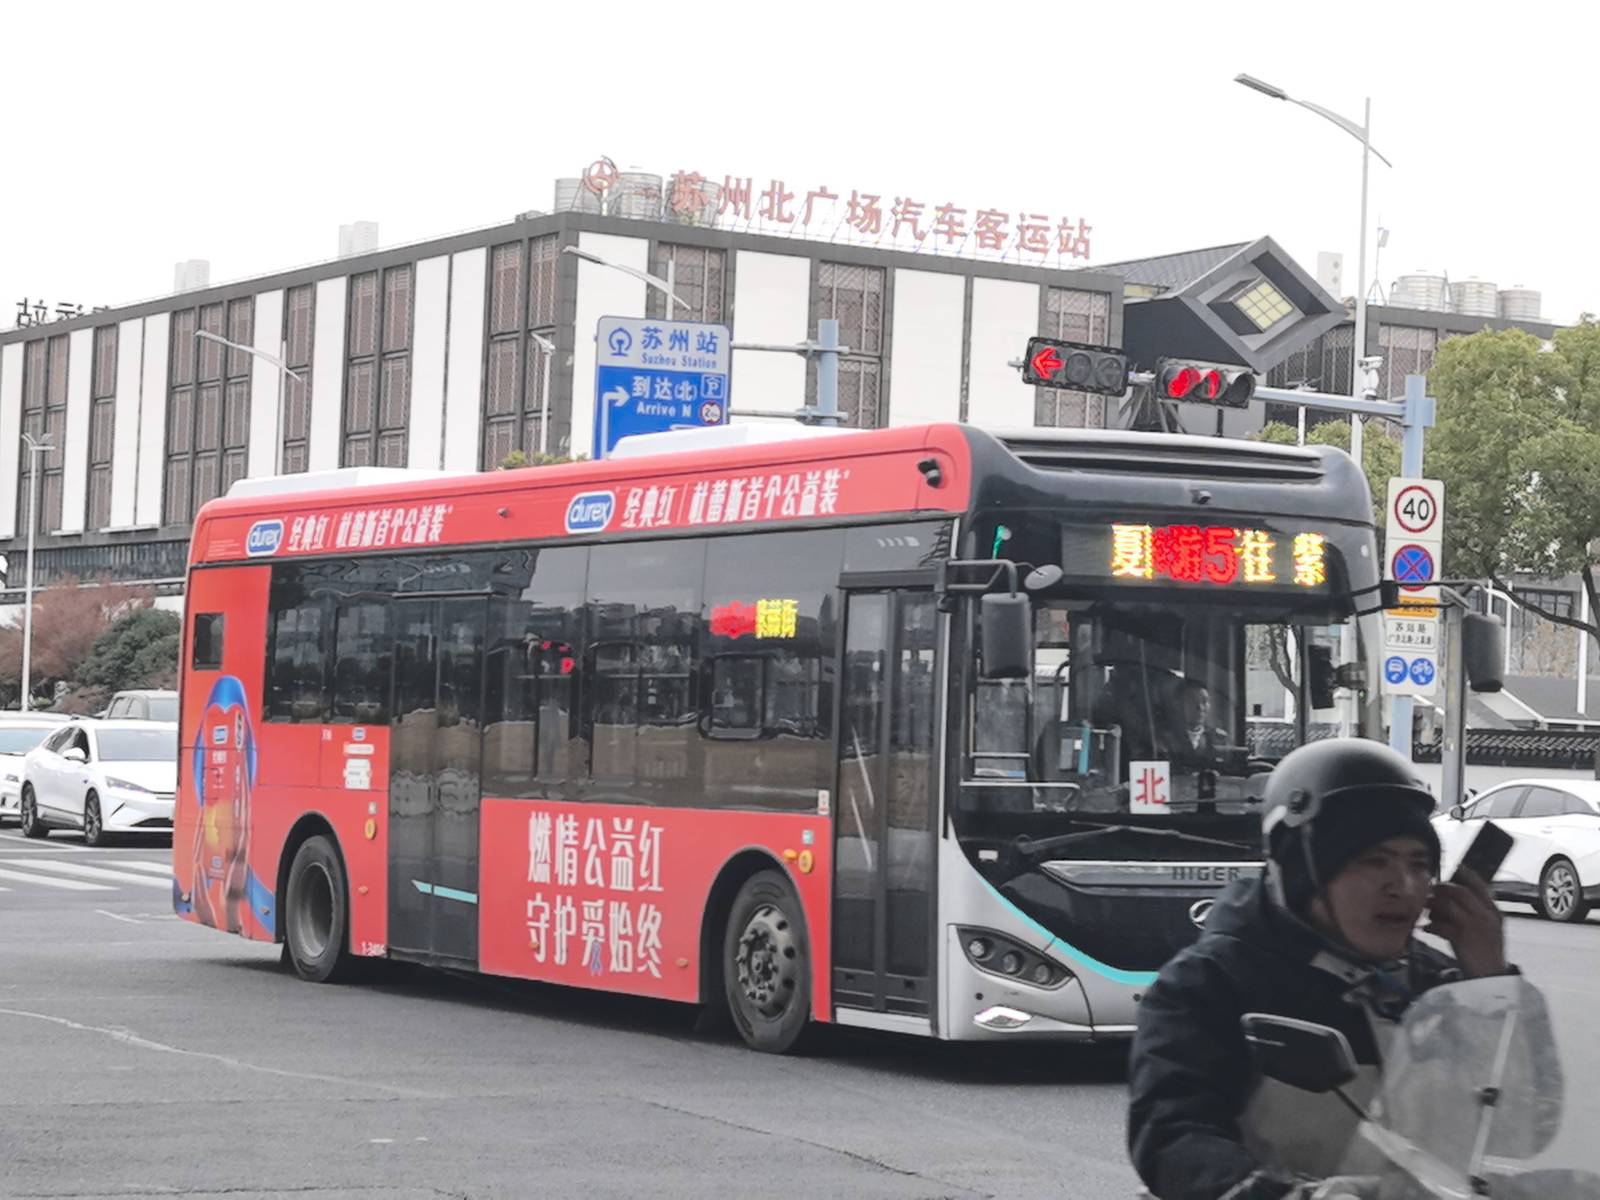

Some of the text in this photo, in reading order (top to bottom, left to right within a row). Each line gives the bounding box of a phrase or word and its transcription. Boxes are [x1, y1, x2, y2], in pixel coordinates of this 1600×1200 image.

[670, 168, 1093, 261] 苏州北广场汽车客运站
[641, 326, 719, 354] 苏州站
[641, 353, 717, 369] Suzhou Station
[636, 401, 677, 417] Arrive
[681, 404, 692, 418] N
[1402, 498, 1430, 521] 40
[1135, 767, 1167, 805] 北
[527, 810, 665, 893] 燃情公益红
[1171, 866, 1241, 882] HIGER
[526, 892, 664, 979] 守护爱始终
